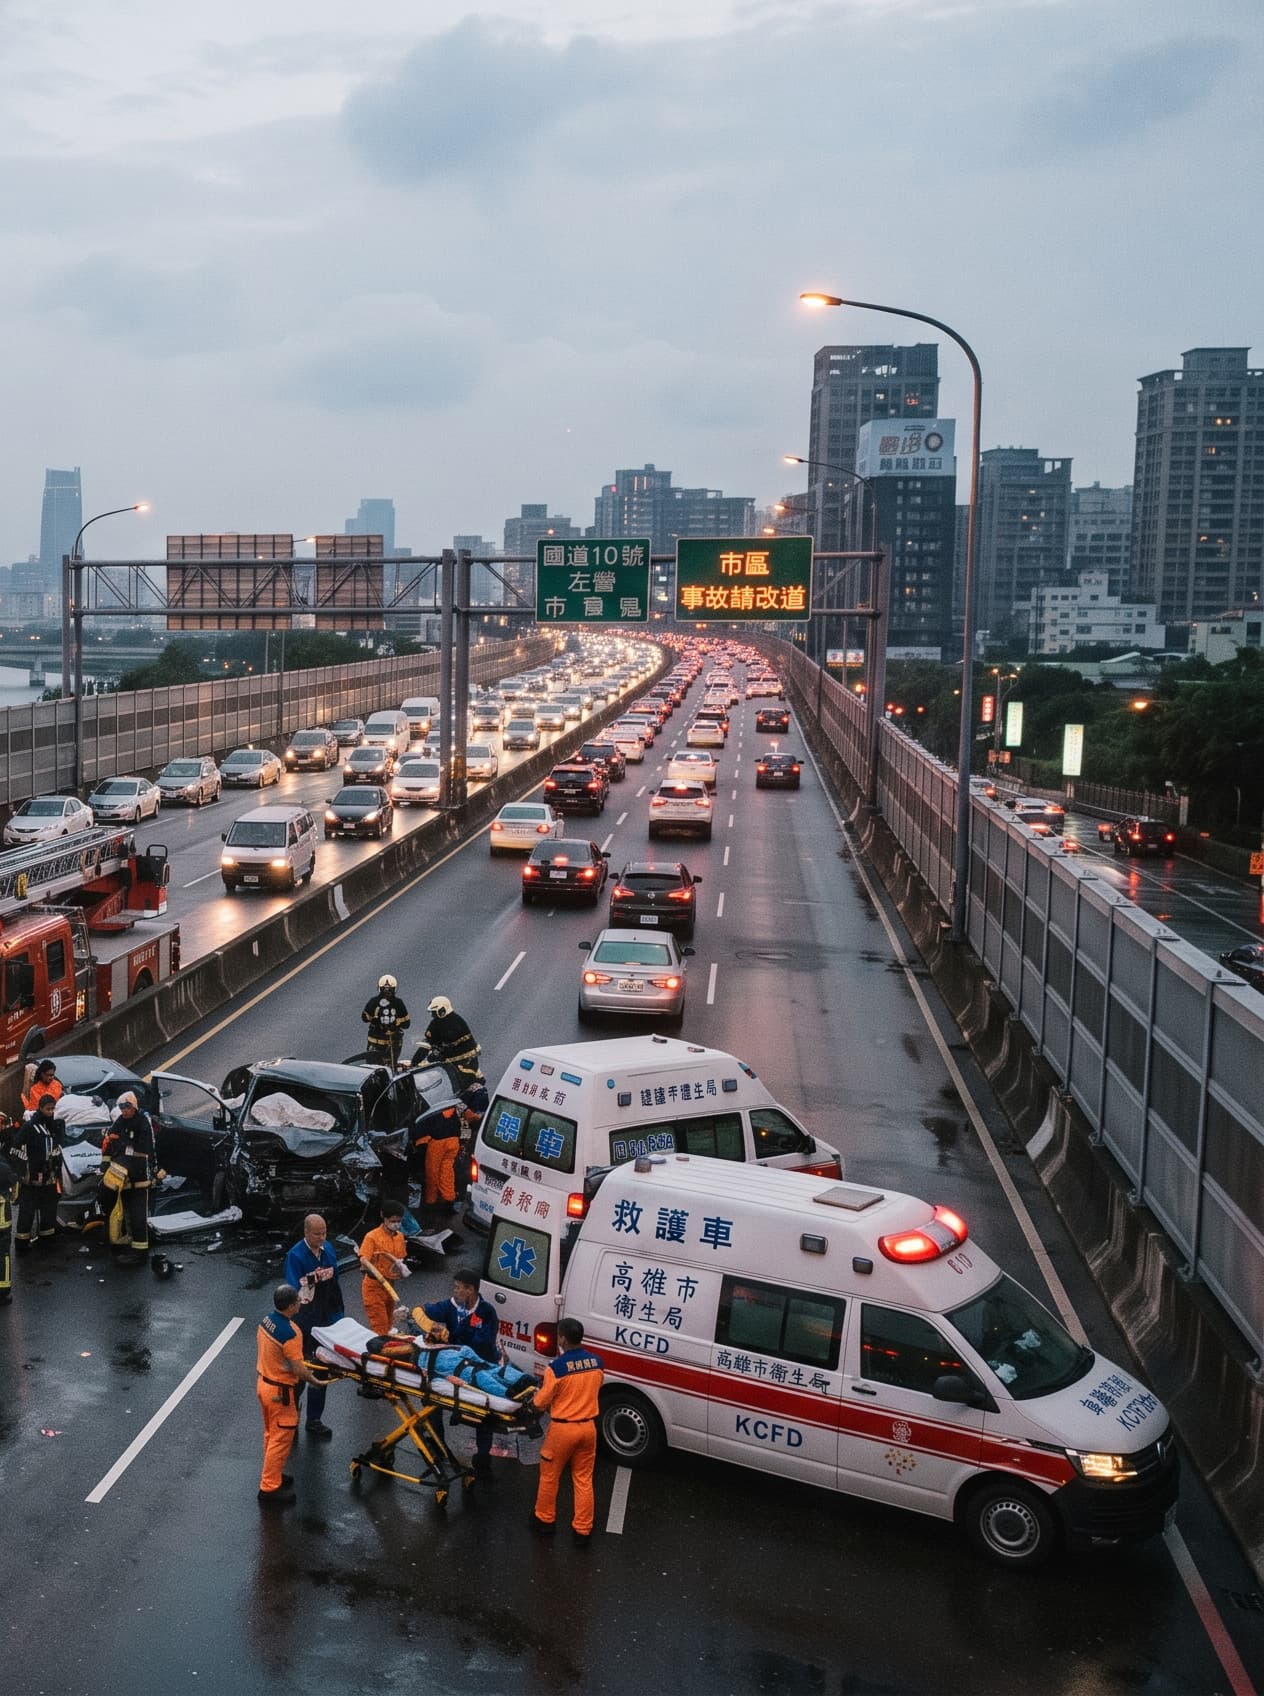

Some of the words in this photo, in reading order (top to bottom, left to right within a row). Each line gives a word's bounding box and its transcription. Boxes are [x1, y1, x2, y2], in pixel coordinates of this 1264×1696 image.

[543, 544, 645, 567] 國道10號
[719, 551, 770, 577] 市區
[680, 584, 807, 611] 事故請改道
[611, 1199, 734, 1251] 救護車
[611, 1260, 699, 1304] 高雄市
[613, 1293, 683, 1331] 衛生局
[615, 1326, 670, 1355] KCFD
[735, 1414, 804, 1448] KCFD
